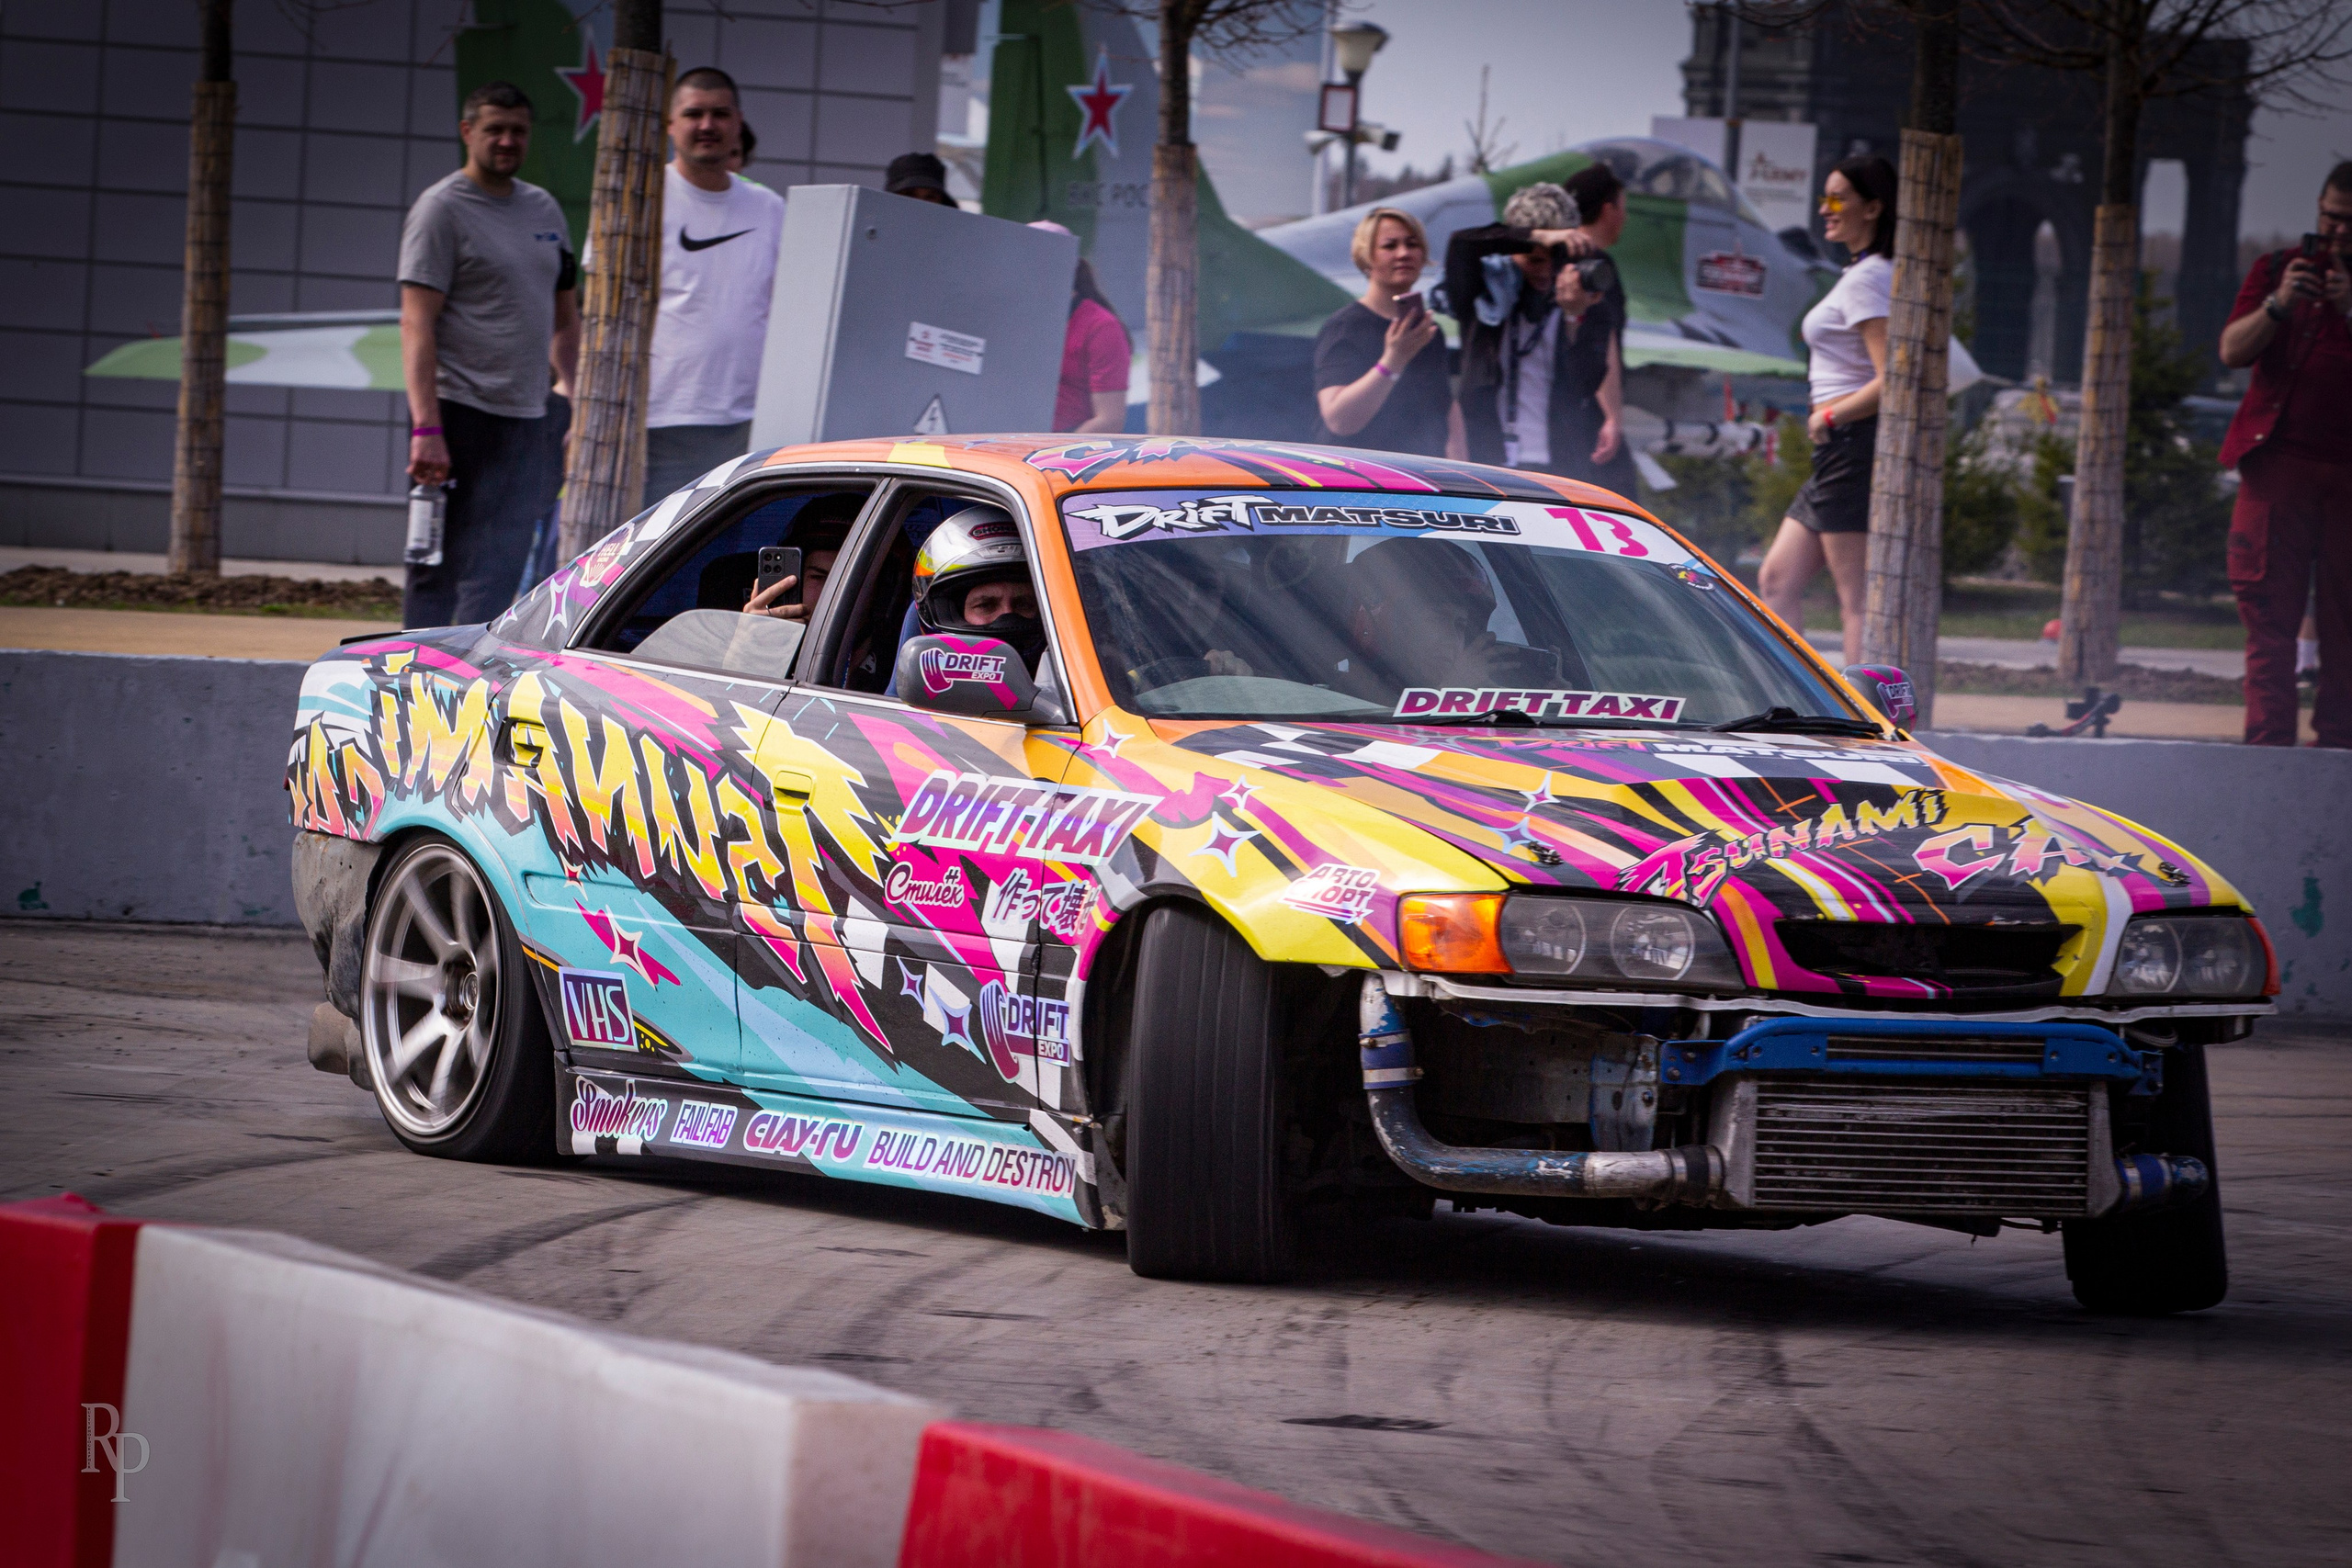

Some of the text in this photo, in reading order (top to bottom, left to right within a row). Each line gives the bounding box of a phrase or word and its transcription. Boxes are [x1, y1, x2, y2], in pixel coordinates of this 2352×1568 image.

[1066, 494, 1521, 539] DRIFT MATSURI
[972, 525, 1020, 536] SHO
[944, 654, 1004, 671] DRIFT
[970, 671, 997, 681] EXPO
[1399, 691, 1679, 720] DRIFT TAXI
[1652, 743, 1919, 764] MATSURI
[899, 777, 1152, 858] DRIFT TAXI
[1306, 865, 1376, 888] АВТО
[566, 981, 629, 1042] VHS
[1008, 995, 1070, 1040] DRIFT
[1038, 1041, 1065, 1059] EXPO
[868, 1131, 1075, 1193] BUILD AND DESTROY
